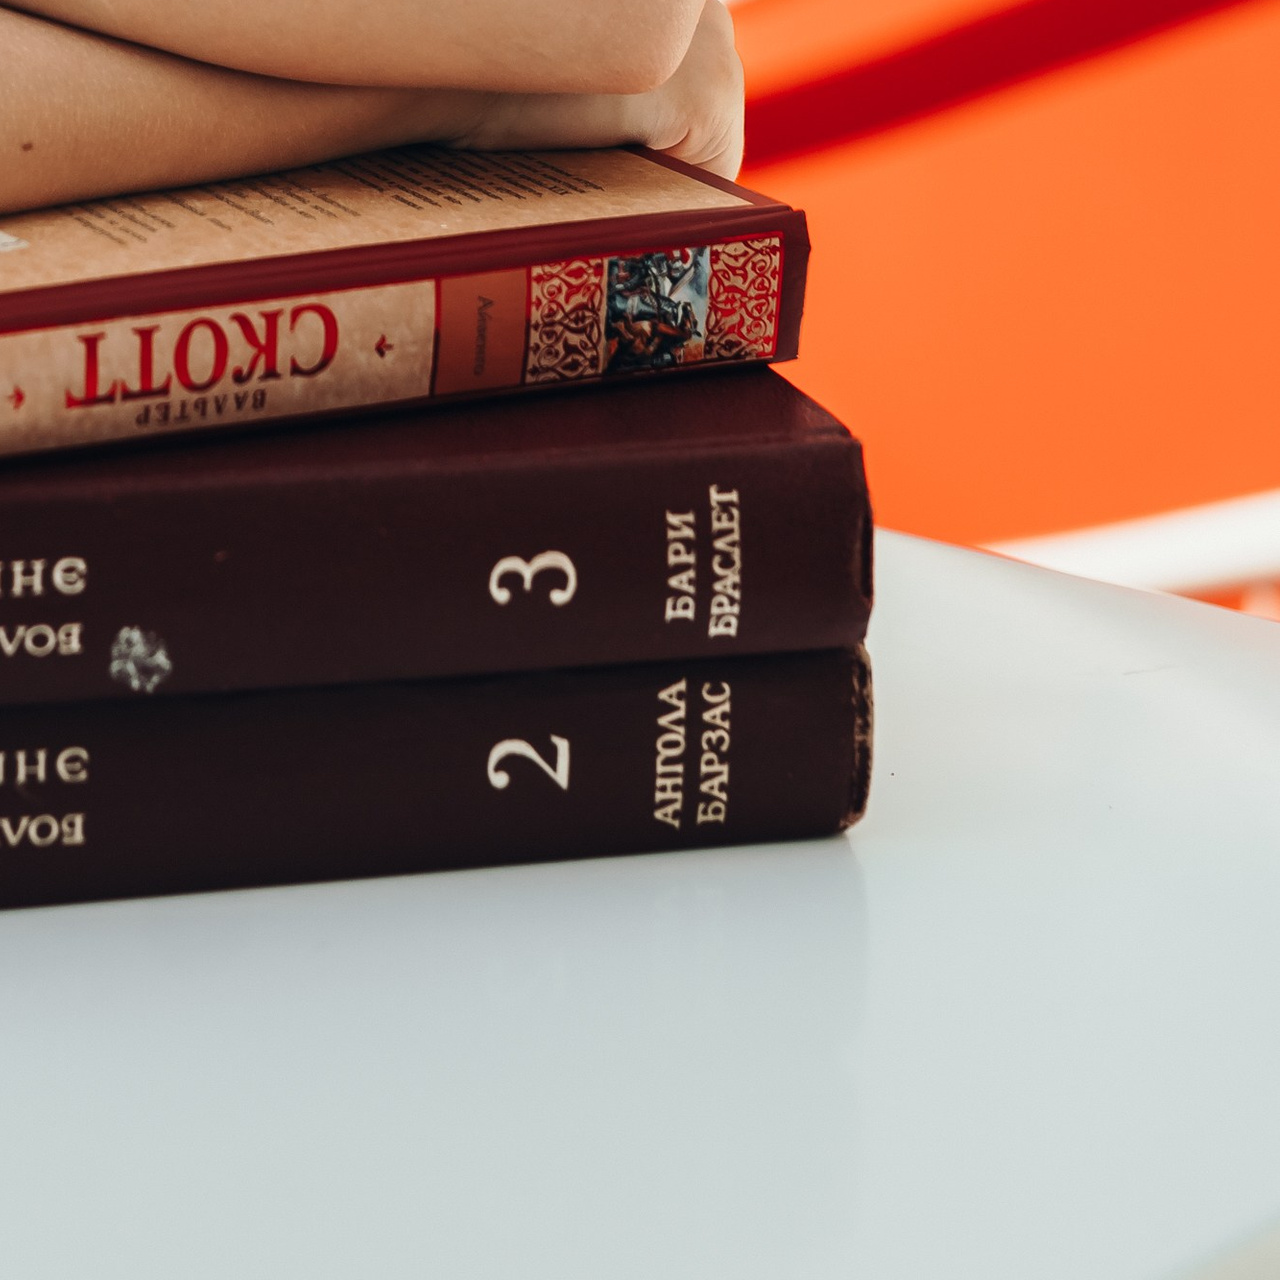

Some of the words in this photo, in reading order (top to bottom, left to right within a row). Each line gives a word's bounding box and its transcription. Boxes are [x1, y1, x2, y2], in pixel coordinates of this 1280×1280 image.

[64, 302, 339, 408] СКОТТ
[135, 388, 267, 427] ВАЛЬТЕР
[489, 550, 577, 606] 3
[665, 510, 696, 622] БАРИ
[708, 484, 741, 638] БРАСЛЕТ
[487, 735, 570, 790] 2
[654, 679, 686, 828] АНГОЛА
[697, 682, 731, 823] БАРЗАС
